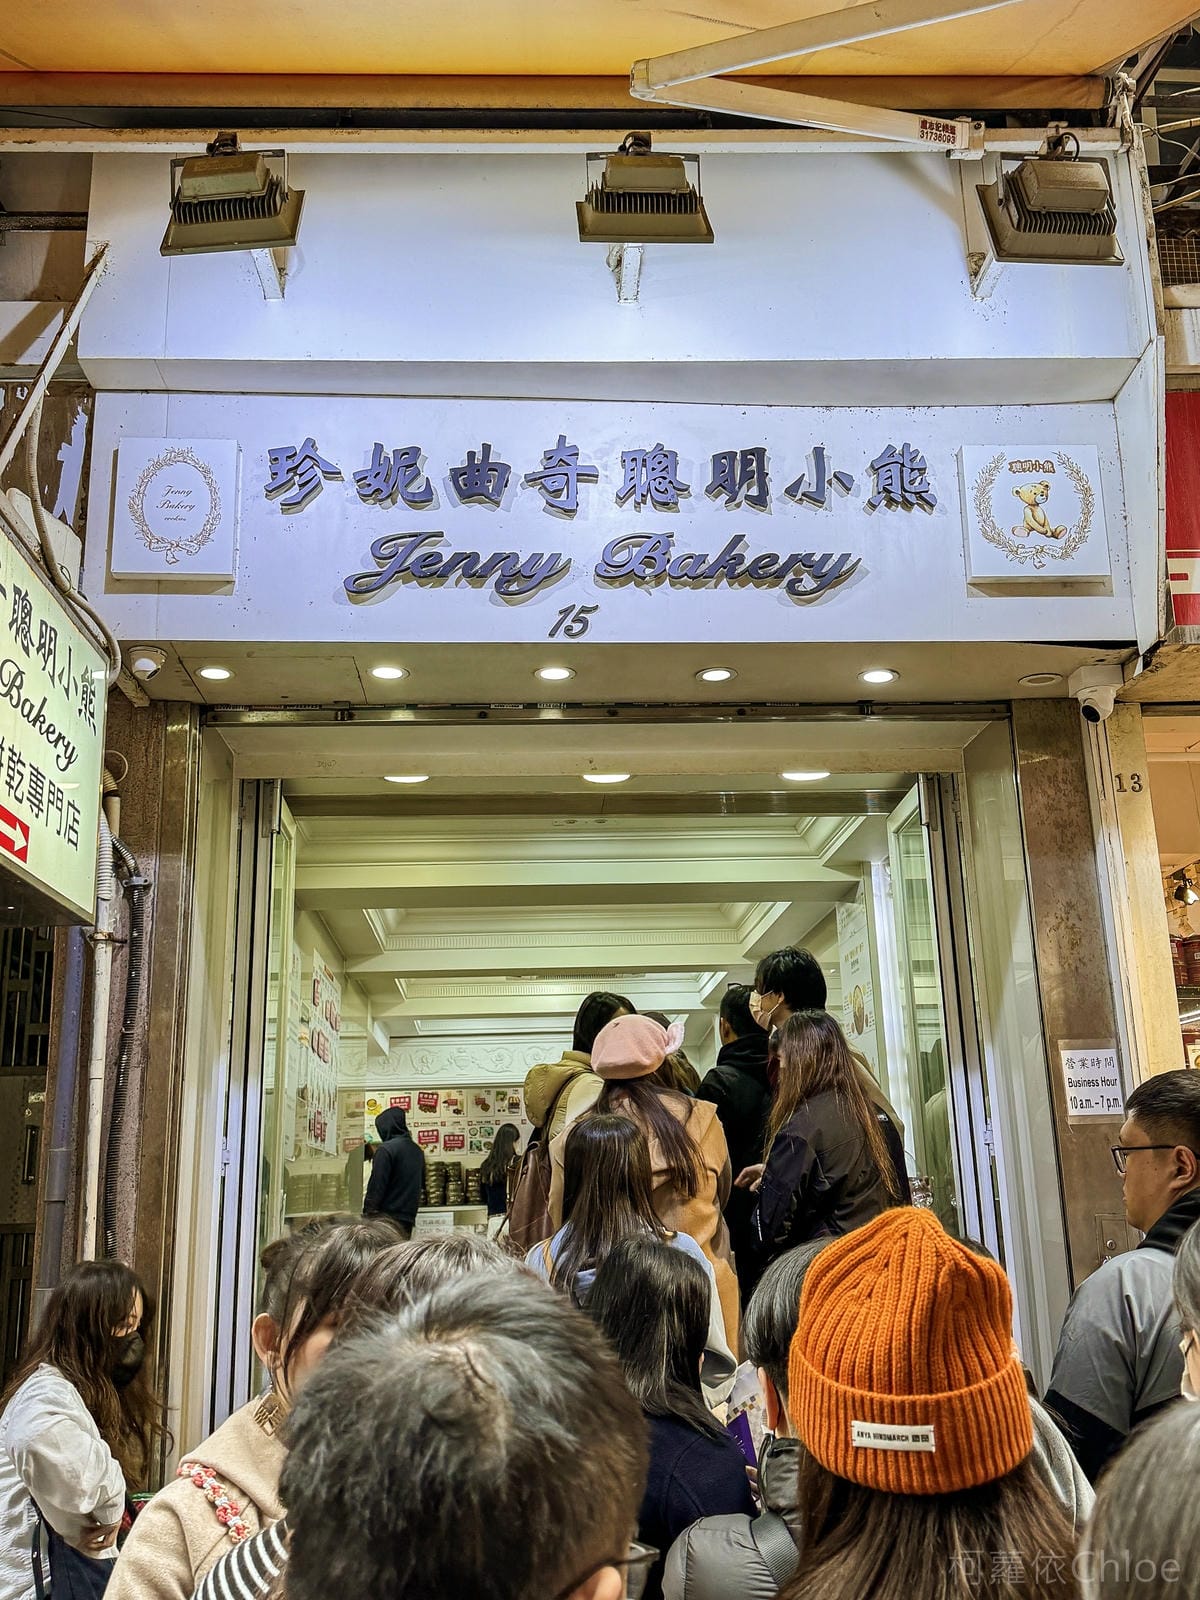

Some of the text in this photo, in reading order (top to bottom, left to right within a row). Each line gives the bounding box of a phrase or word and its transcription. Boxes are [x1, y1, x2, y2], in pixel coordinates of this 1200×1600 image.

[264, 436, 938, 515] 珍妮曲奇聰明小熊
[162, 484, 193, 498] Jenny
[156, 500, 196, 512] Bakery
[344, 531, 862, 601] Jenny Bakery
[548, 604, 599, 639] 15
[0, 562, 97, 737] 聰明小熊
[0, 658, 79, 773] Bakery
[1114, 773, 1144, 793] 13
[1065, 1056, 1115, 1070] 營業時間
[1067, 1076, 1118, 1088] Business Hour
[1070, 1095, 1078, 1109] 10
[1100, 1095, 1105, 1108] 7
[1106, 1097, 1122, 1111] p.m.
